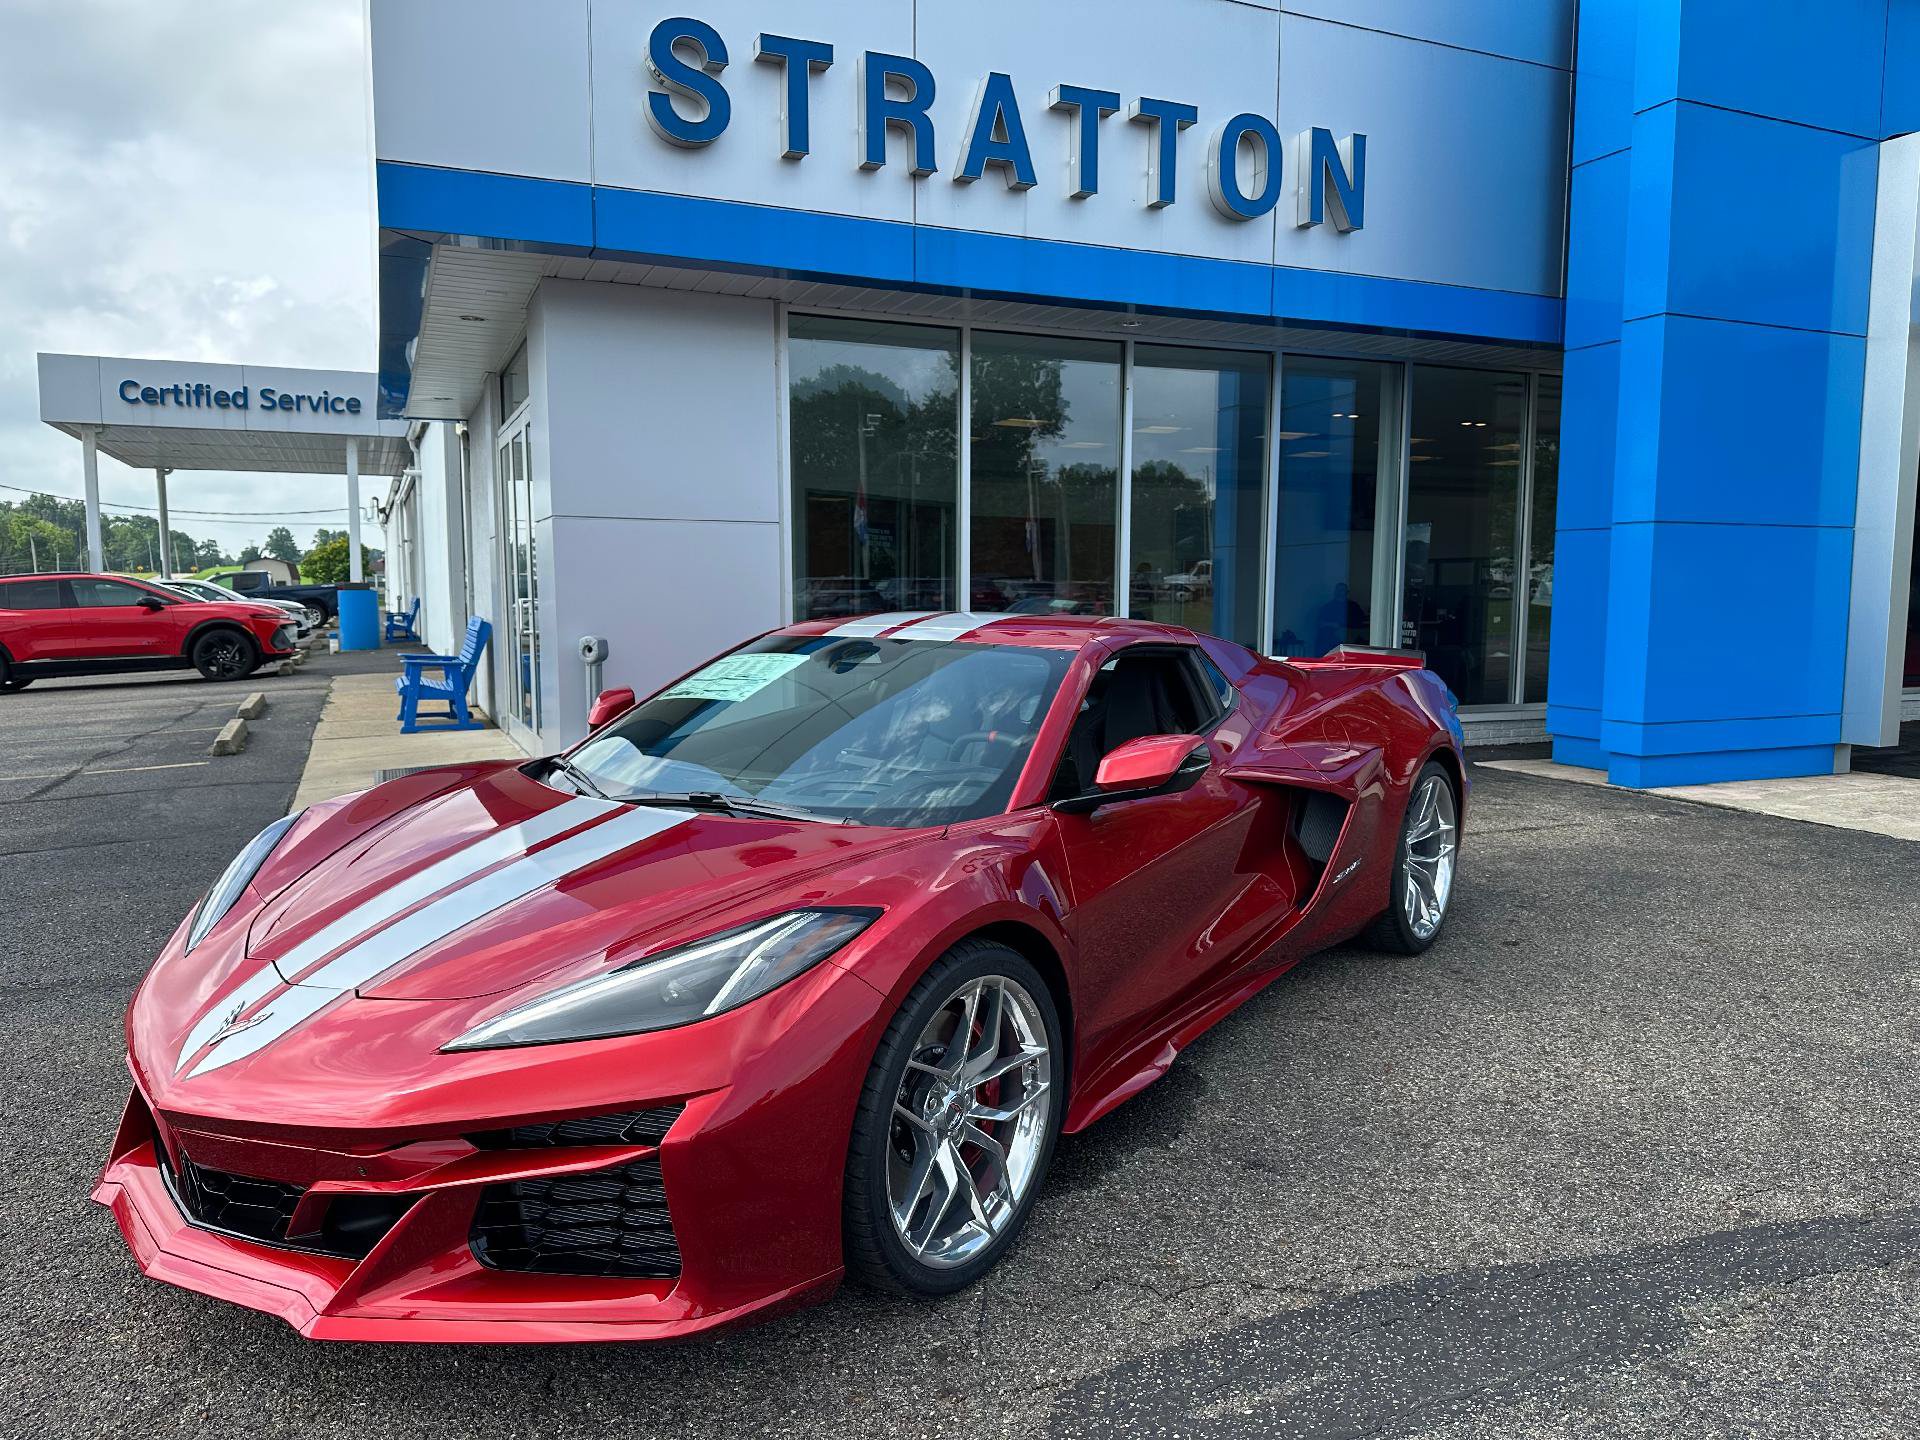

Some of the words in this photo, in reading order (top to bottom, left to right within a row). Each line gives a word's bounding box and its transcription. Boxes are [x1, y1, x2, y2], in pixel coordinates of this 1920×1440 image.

[645, 17, 1367, 231] STRATTON
[118, 379, 249, 411] Certified
[259, 387, 362, 415] Service
